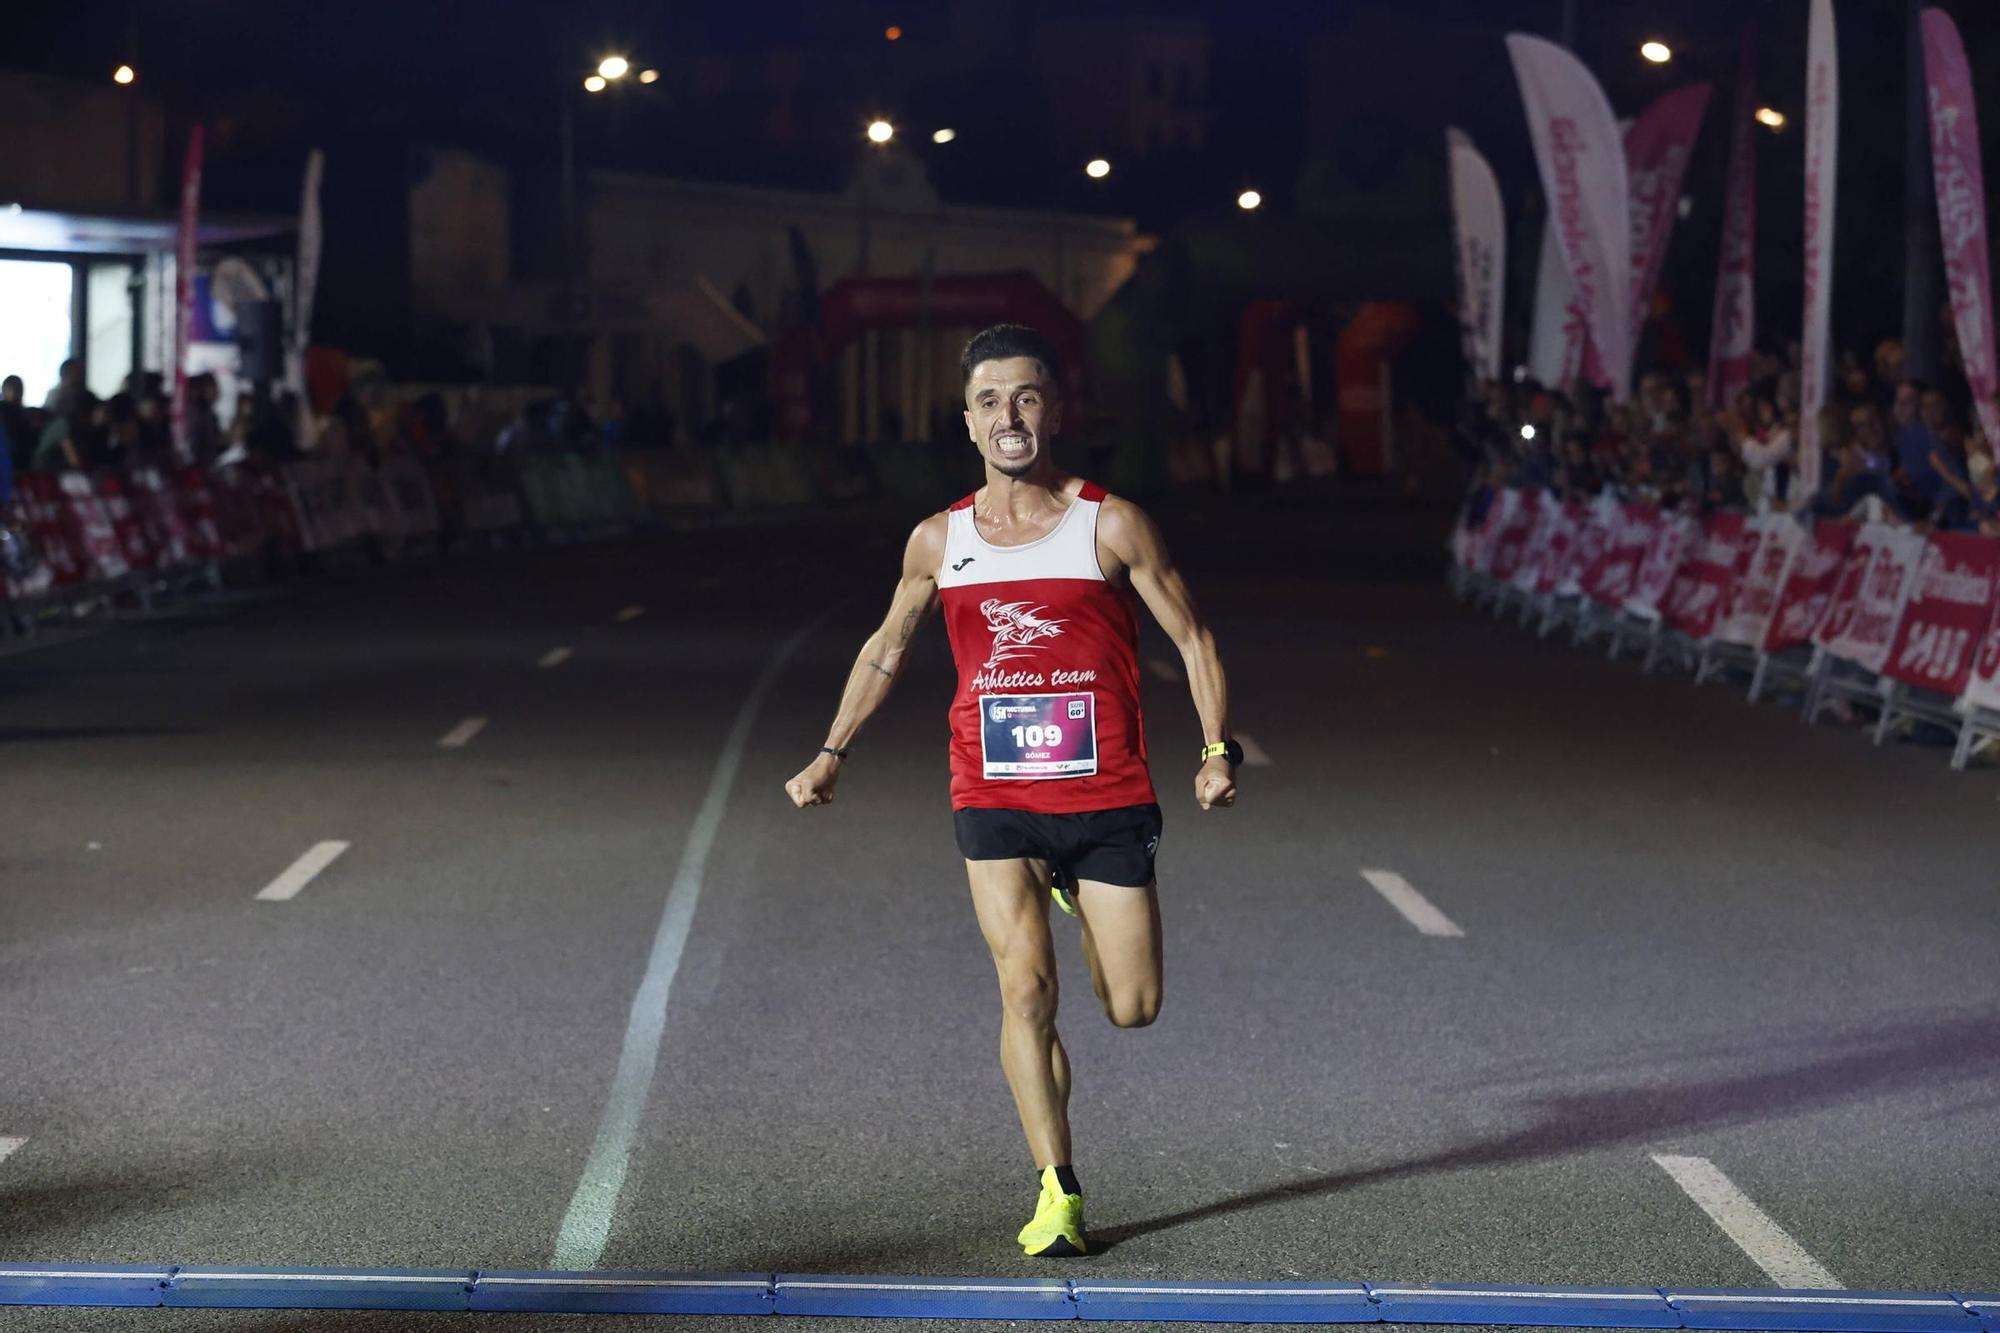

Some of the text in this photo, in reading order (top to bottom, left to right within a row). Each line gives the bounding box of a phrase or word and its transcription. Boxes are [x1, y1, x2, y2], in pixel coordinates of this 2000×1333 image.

[971, 668, 1096, 692] Athletics team
[1011, 725, 1063, 748] 109
[1025, 751, 1052, 760] GÓMEZ
